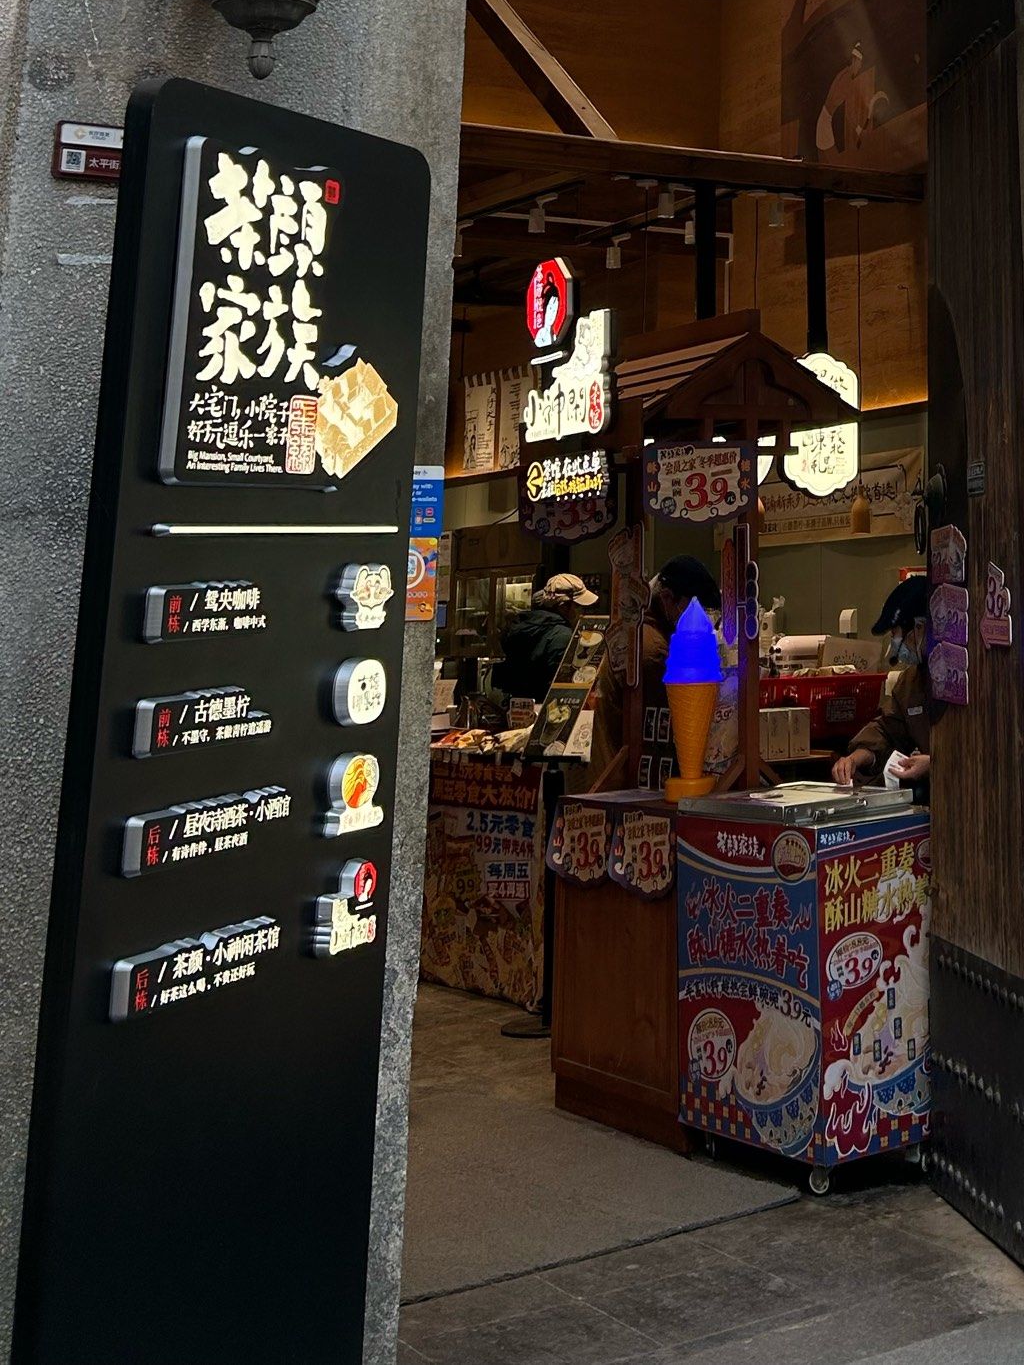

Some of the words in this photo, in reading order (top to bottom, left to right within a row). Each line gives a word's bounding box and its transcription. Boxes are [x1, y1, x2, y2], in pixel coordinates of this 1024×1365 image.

[196, 275, 323, 390] 家族
[186, 459, 196, 470] An
[196, 460, 230, 474] Interesting
[230, 462, 250, 474] Family
[250, 464, 265, 473] Lives
[187, 450, 199, 461] Big
[227, 452, 244, 462] Small
[204, 587, 261, 612] 鸳央咖啡
[194, 695, 251, 724] 古德墨柠
[183, 794, 292, 839] 昼夜诗酒茶·小酒馆
[465, 810, 535, 837] 2.5元零食
[486, 862, 530, 880] 每周五
[823, 842, 915, 896] 冰火二重奏
[702, 876, 792, 930] 冰火二重奏
[172, 925, 281, 980] 茶颜·小神闲茶馆
[686, 922, 810, 991] 酥山糖水热着吃
